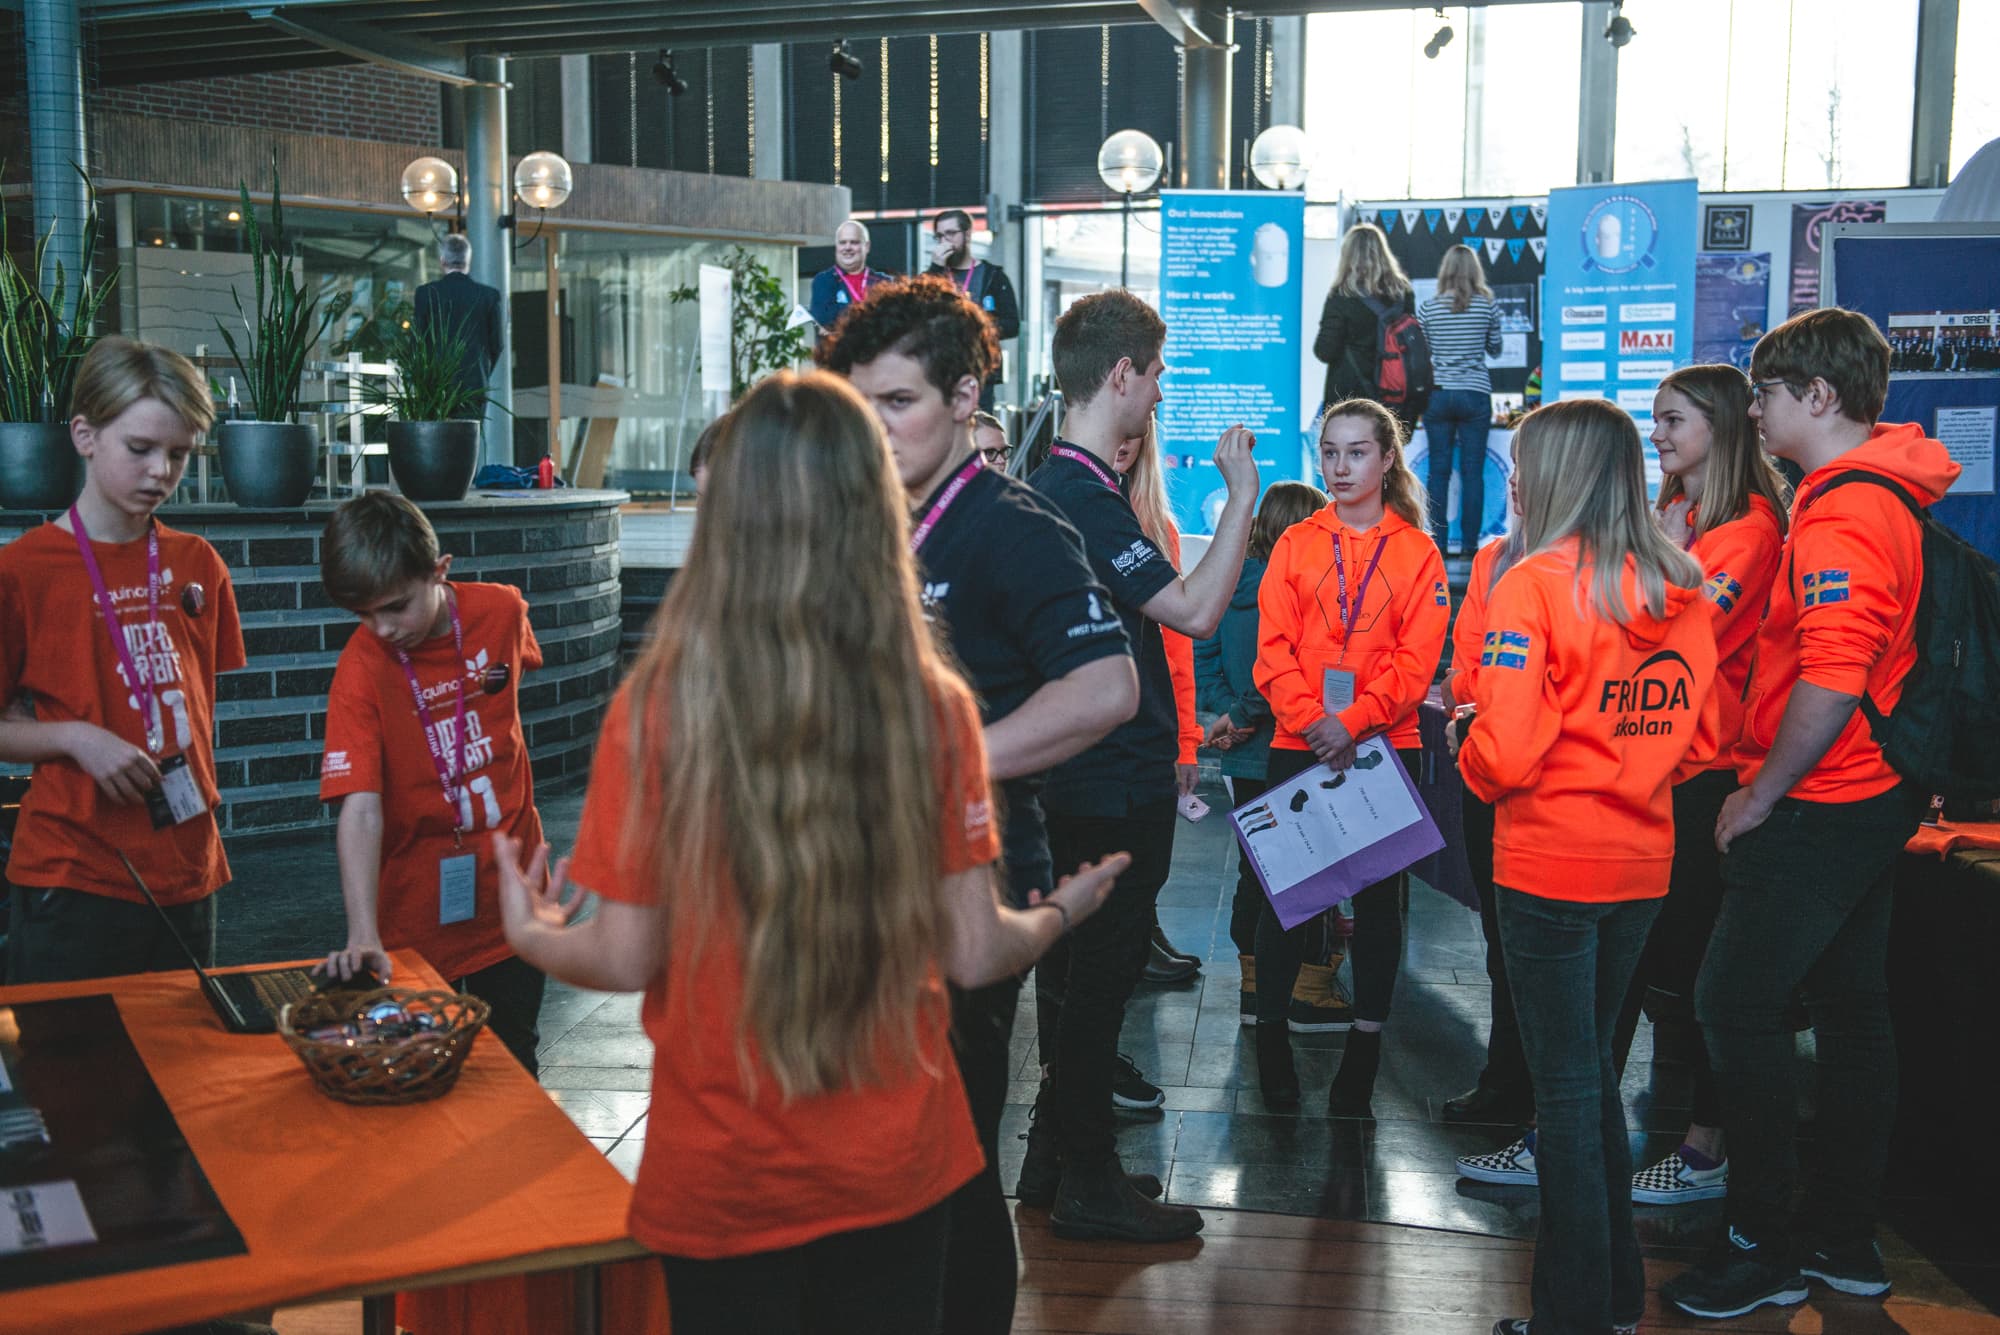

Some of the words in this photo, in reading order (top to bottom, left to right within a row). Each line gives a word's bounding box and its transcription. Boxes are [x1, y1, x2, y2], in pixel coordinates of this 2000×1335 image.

[1166, 367, 1210, 375] Partners
[1088, 461, 1110, 484] VISITOR
[422, 678, 465, 700] quino
[1598, 678, 1690, 712] FRIDA
[1613, 715, 1672, 737] skolan
[424, 726, 441, 758] VISITOR
